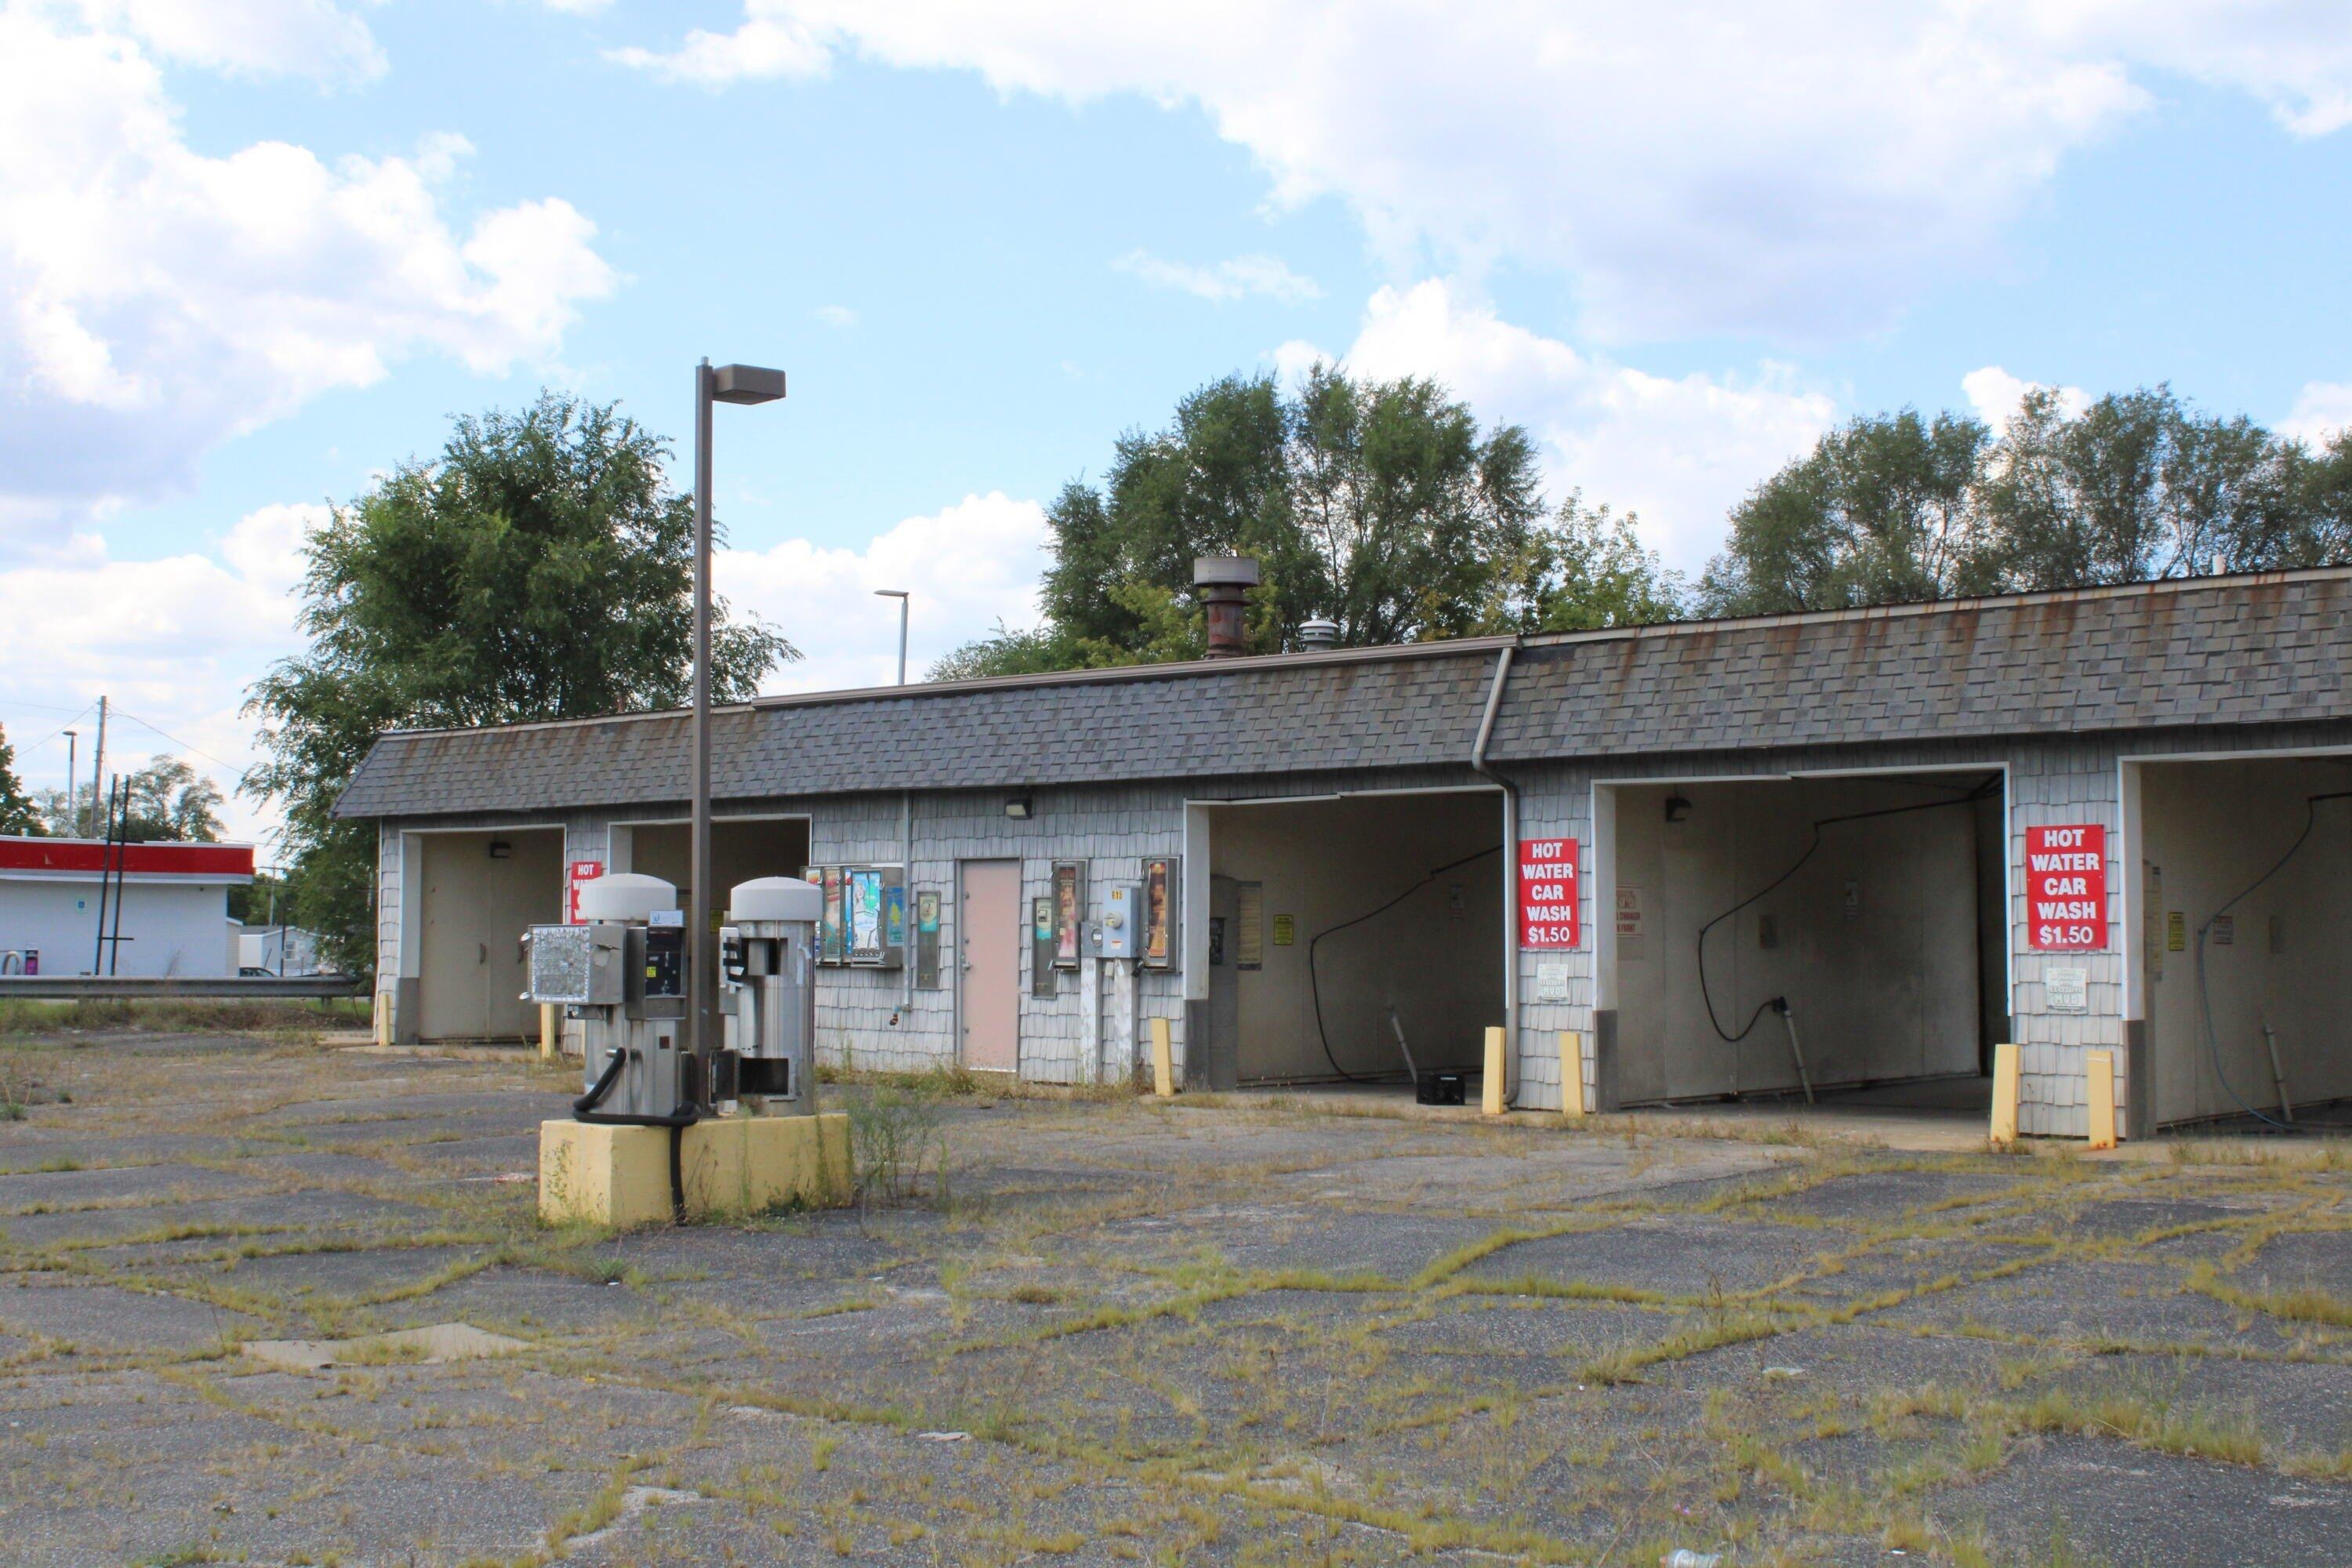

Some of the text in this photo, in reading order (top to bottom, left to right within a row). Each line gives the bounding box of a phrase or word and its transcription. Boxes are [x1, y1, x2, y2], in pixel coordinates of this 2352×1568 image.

[2044, 829, 2085, 848] HOT
[1532, 842, 1563, 858] HOT
[578, 864, 594, 876] HOT
[2031, 853, 2100, 871] WATER
[1522, 863, 1573, 880] WATER
[1531, 884, 1563, 901] CAR
[2044, 877, 2087, 895] CAR
[1526, 906, 1571, 922] WASH
[2037, 902, 2096, 920] WASH
[1528, 926, 1570, 945] $1.50
[2039, 925, 2093, 946] $1.50
